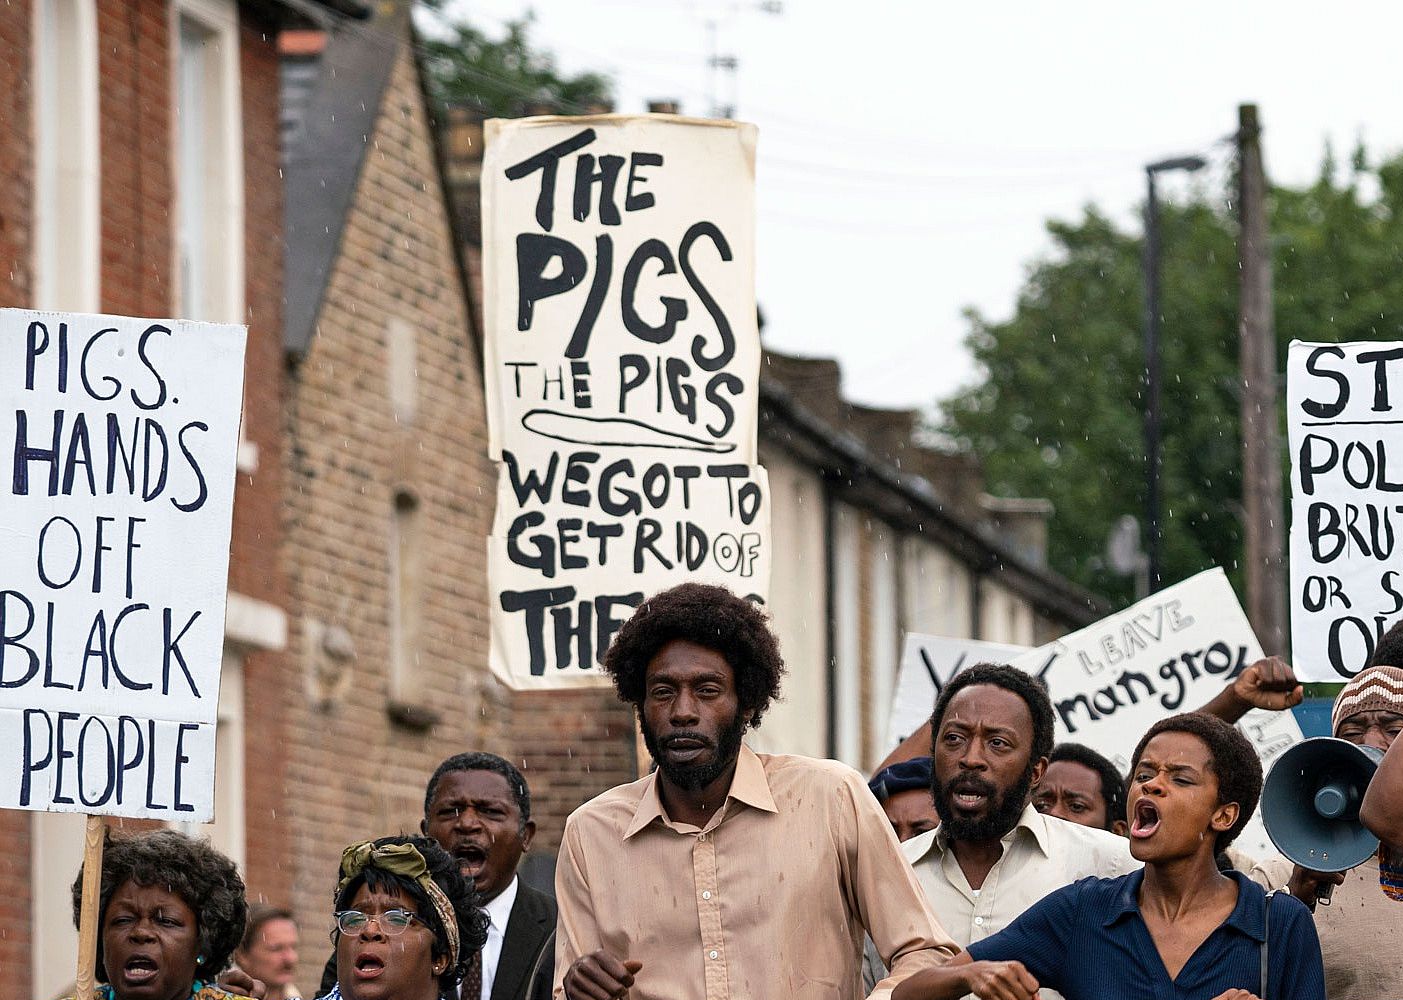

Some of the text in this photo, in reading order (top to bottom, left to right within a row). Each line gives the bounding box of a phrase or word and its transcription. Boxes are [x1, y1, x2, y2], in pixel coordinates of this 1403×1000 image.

[505, 128, 663, 232] THE
[517, 221, 735, 372] PIGS
[25, 321, 180, 411] PIGS.
[504, 352, 744, 438] THE PIGS
[12, 409, 209, 513] HANDS
[502, 450, 762, 526] WE GOT TO
[37, 516, 147, 600] OFF
[506, 510, 762, 578] GET RID OF
[1077, 600, 1197, 676] LEAVE
[1302, 575, 1351, 613] OR
[0, 588, 202, 699] BLACK
[19, 708, 200, 813] PEOPLE
